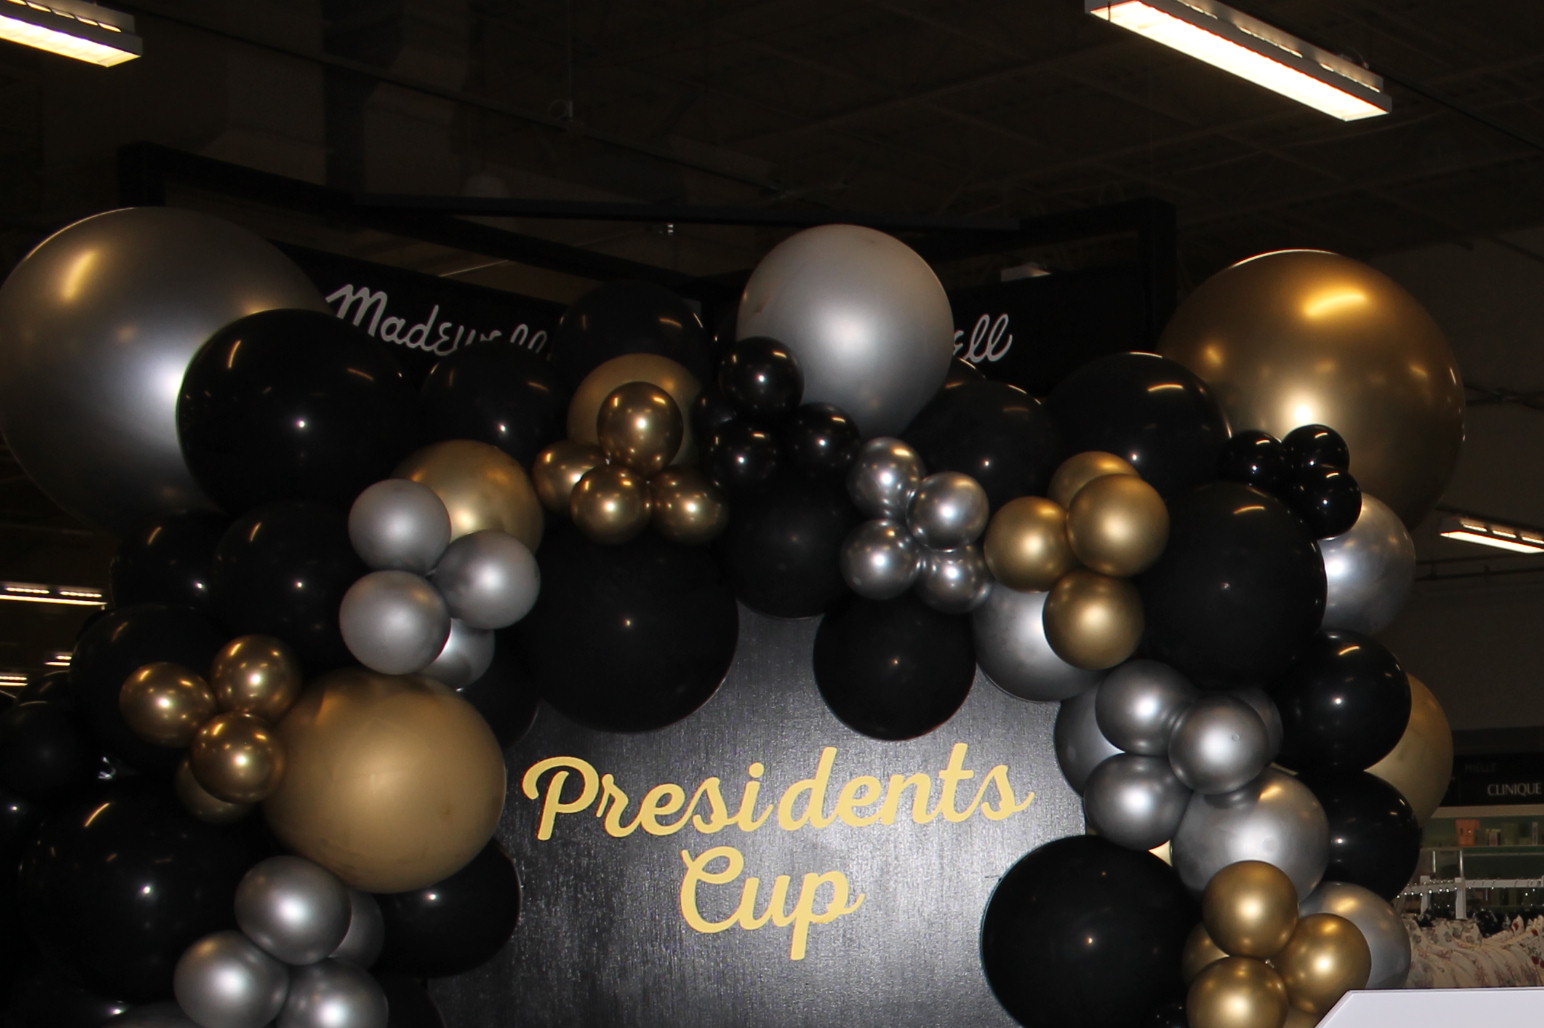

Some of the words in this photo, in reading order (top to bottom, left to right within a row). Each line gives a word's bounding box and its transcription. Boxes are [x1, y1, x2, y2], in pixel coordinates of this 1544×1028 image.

[522, 743, 1035, 841] Presidents
[1487, 782, 1542, 797] CLINIQUE
[680, 846, 866, 960] Cup
